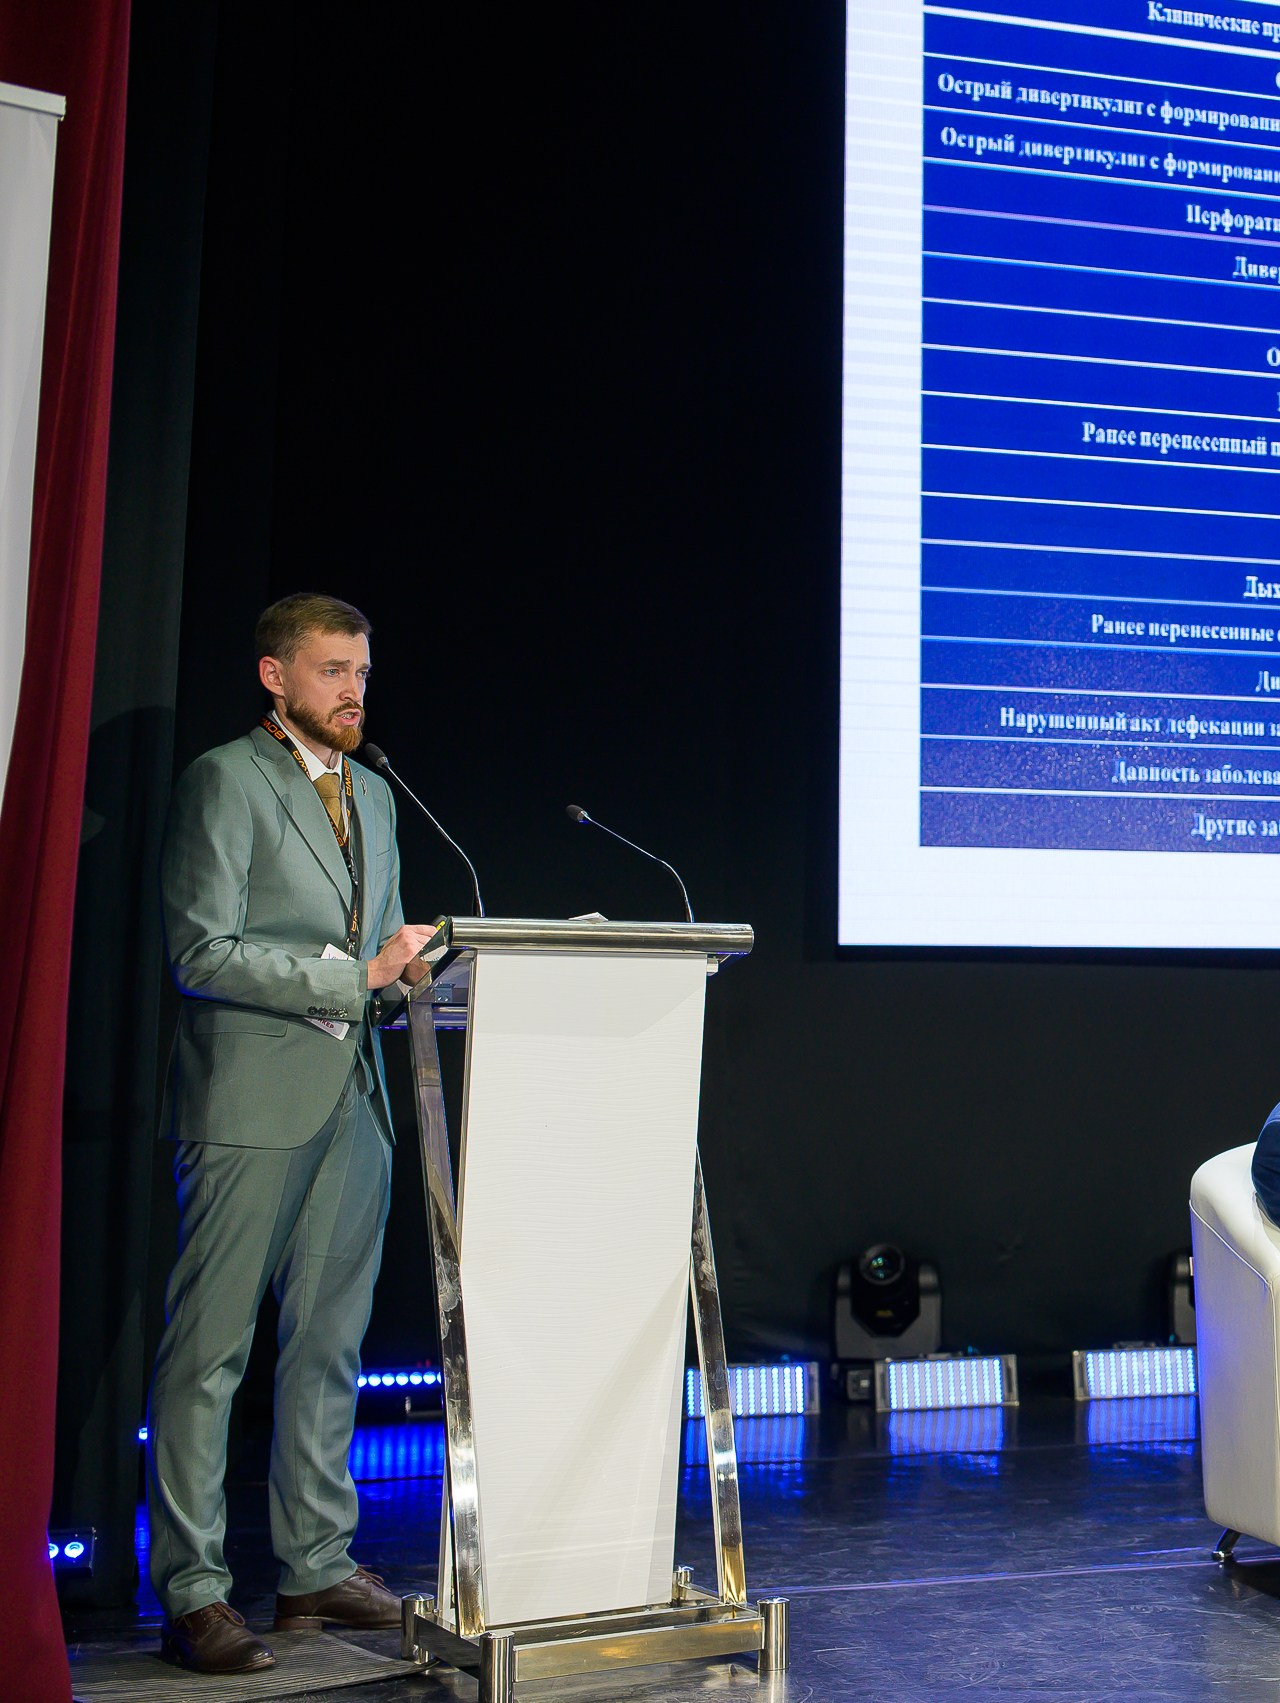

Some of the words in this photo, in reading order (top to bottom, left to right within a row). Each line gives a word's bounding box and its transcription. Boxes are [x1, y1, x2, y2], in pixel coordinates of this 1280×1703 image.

[1149, 1, 1260, 34] Клинические
[938, 74, 1011, 100] Острый
[1017, 88, 1143, 115] дивертикулит
[1147, 104, 1155, 116] с
[941, 127, 1014, 155] Острый
[1020, 143, 1144, 169] дивертикулит
[1151, 158, 1158, 168] с
[1083, 423, 1136, 444] Ранее
[1092, 614, 1144, 635] Ранее
[1149, 623, 1273, 642] перенесенные
[1001, 707, 1127, 735] Нарушенный
[1130, 716, 1161, 732] акт
[1167, 715, 1264, 739] дефекации
[343, 759, 352, 797] BOWA
[1112, 760, 1200, 783] Давность
[1191, 814, 1256, 841] Другие
